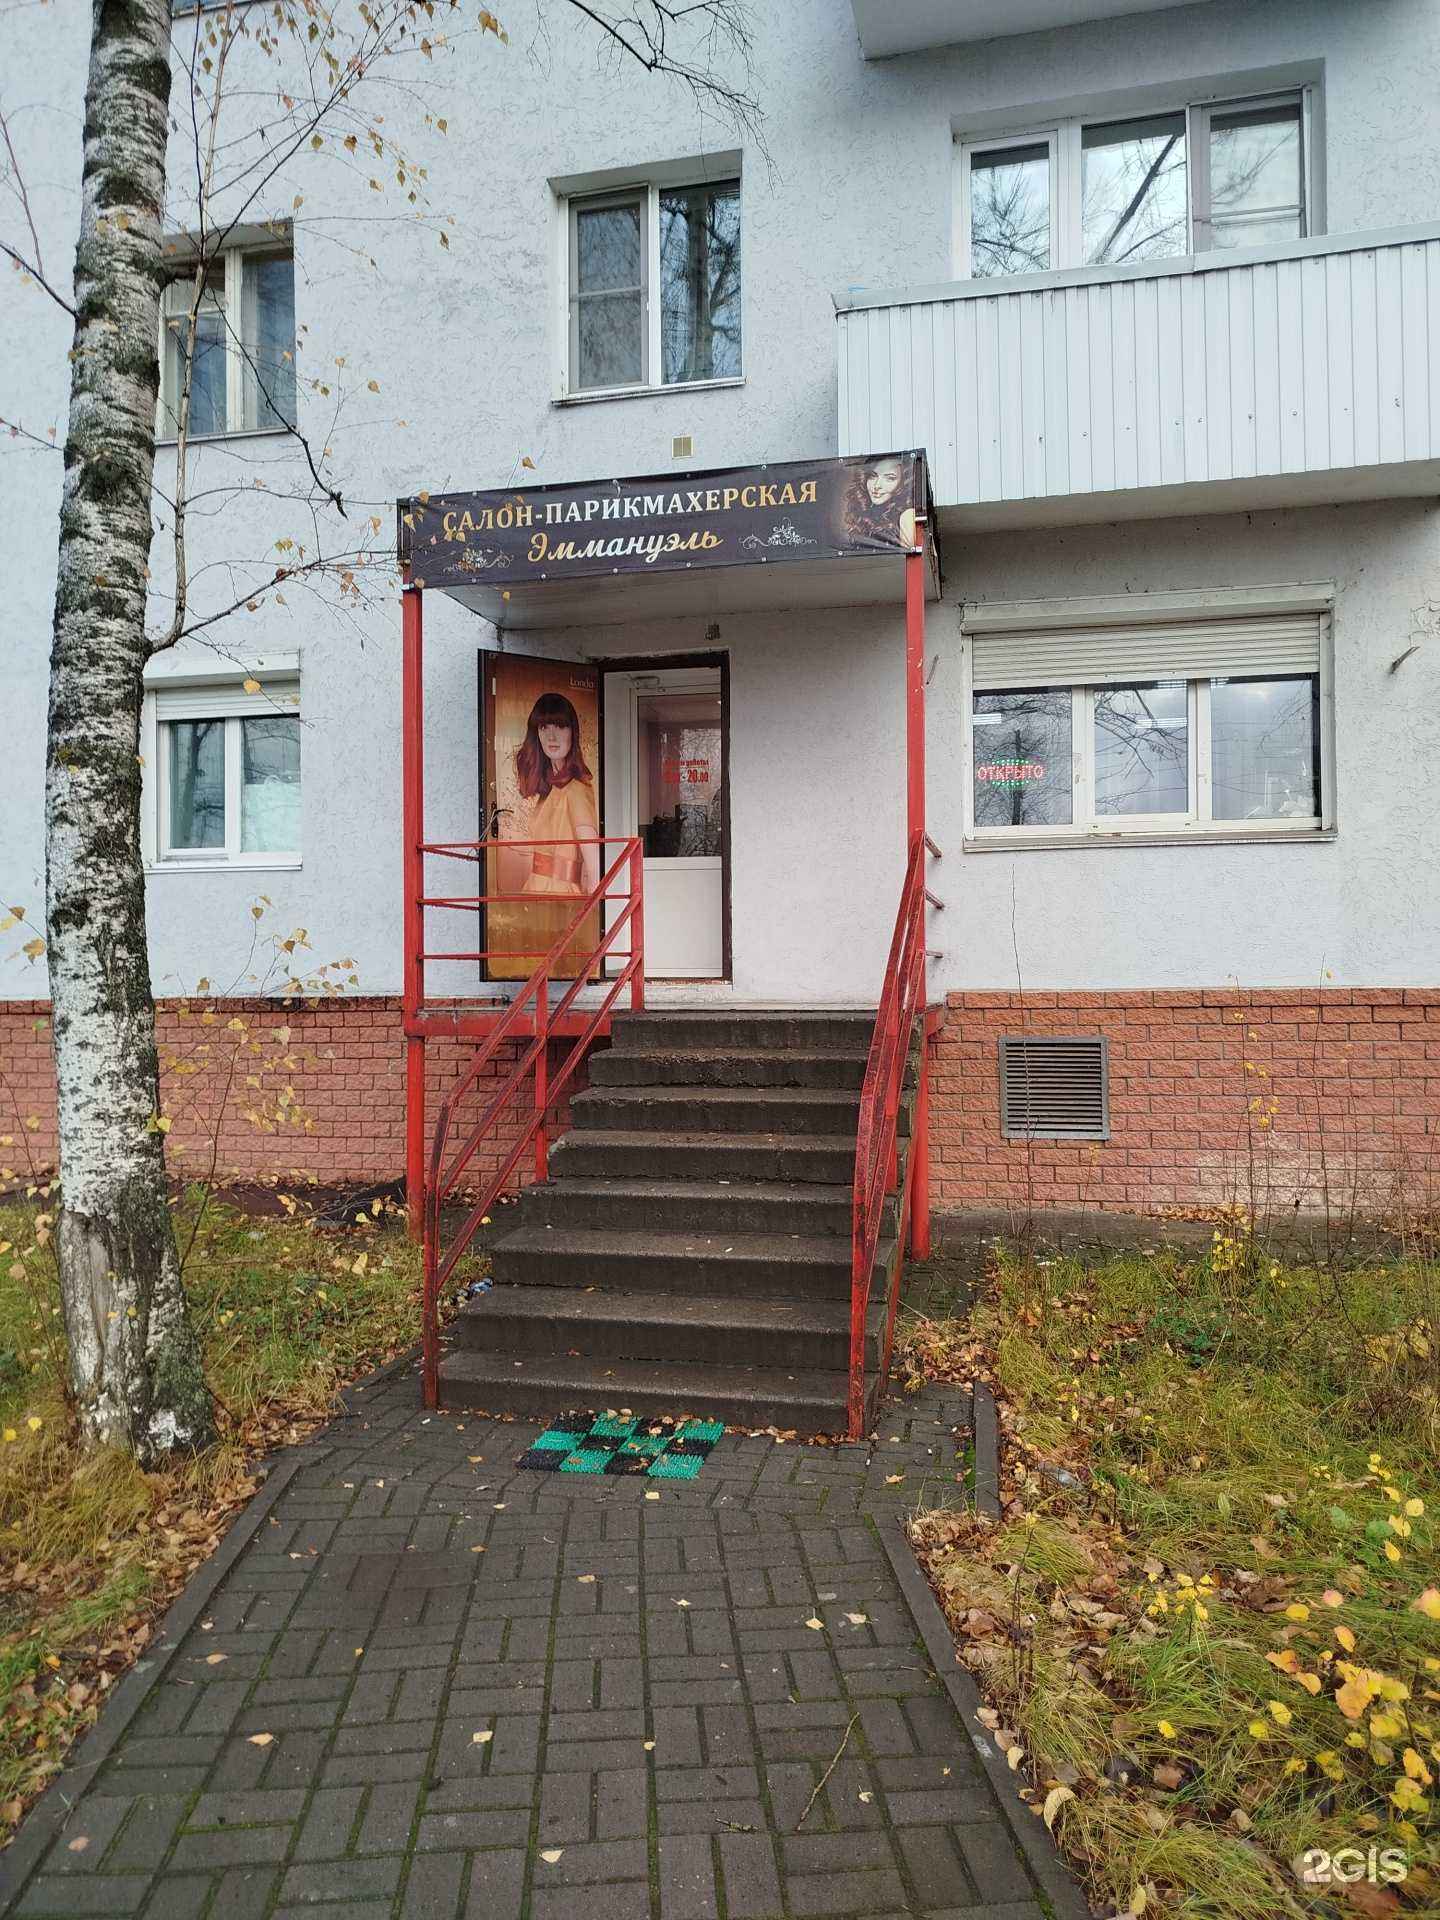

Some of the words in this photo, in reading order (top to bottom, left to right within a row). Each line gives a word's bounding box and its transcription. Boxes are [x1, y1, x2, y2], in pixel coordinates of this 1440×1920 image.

[443, 481, 817, 532] САЛОН-ПАРИКМАХЕРСКАЯ
[528, 530, 723, 563] Эммануэль
[977, 765, 1044, 780] ОТКРЫТО
